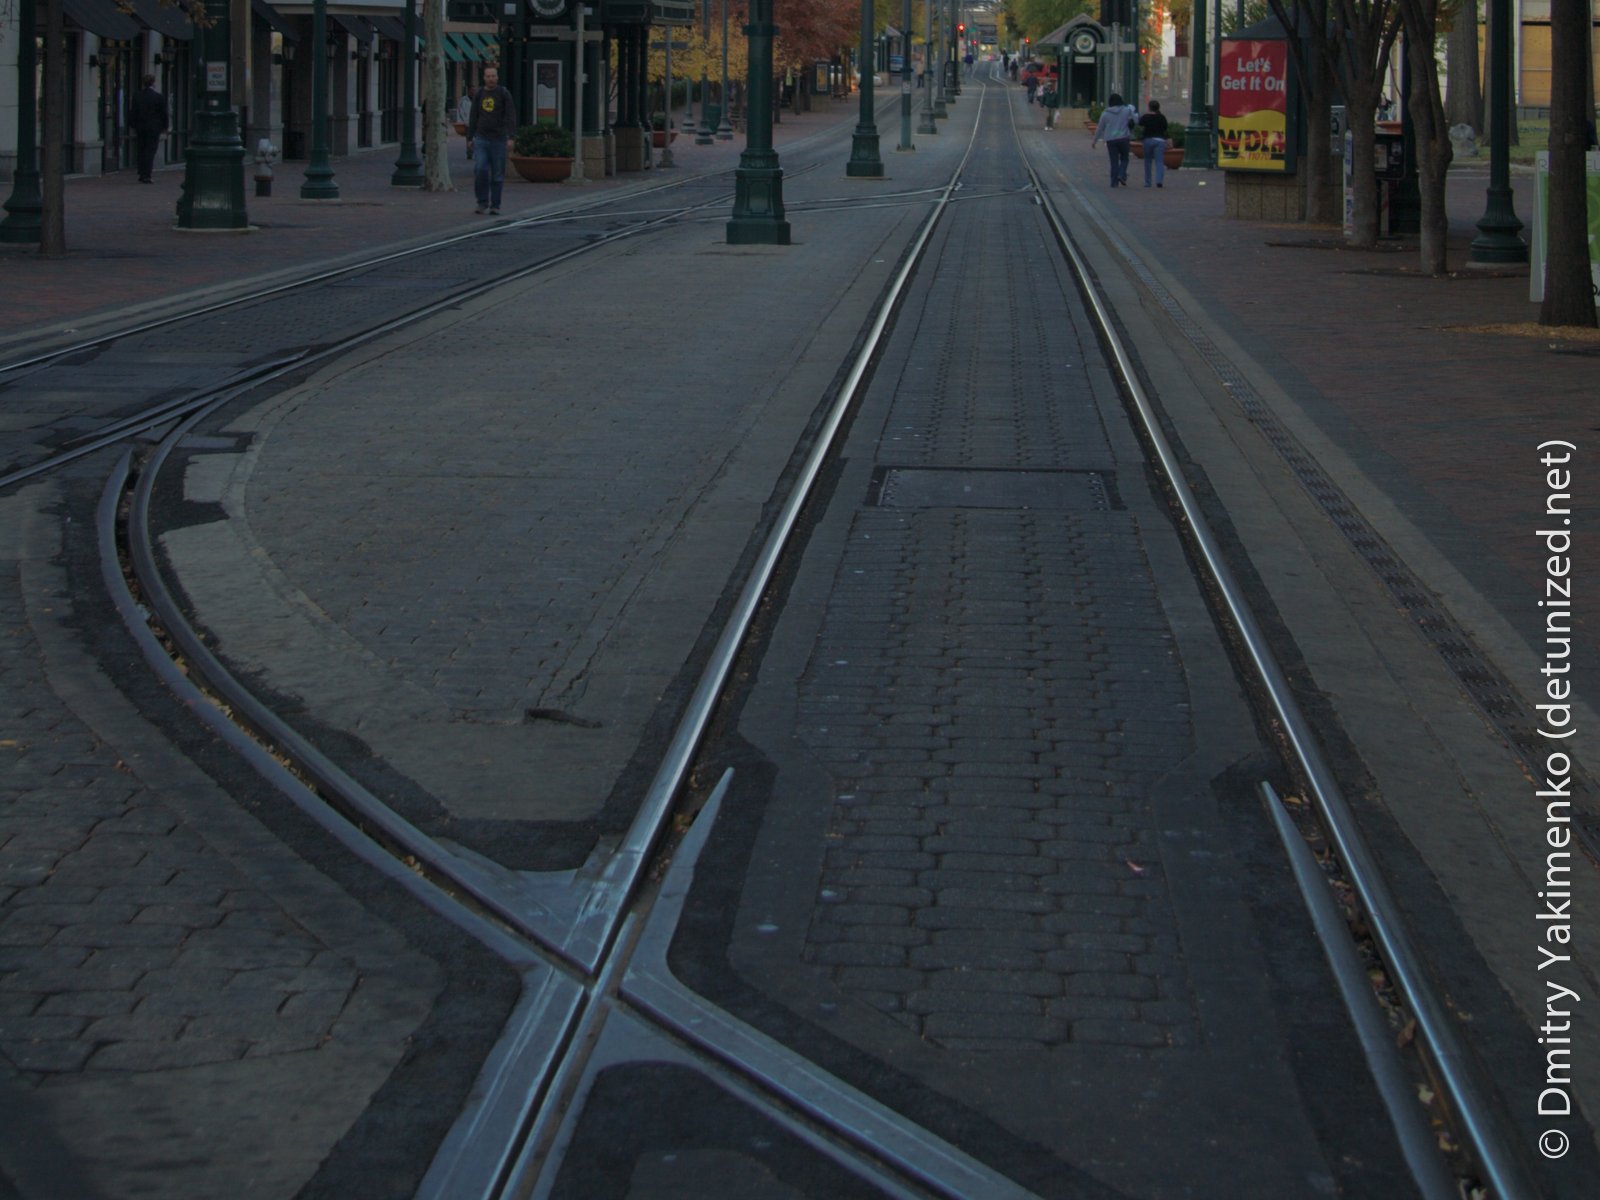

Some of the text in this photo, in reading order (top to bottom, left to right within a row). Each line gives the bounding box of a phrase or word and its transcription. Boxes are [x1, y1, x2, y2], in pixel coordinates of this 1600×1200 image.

[1237, 58, 1272, 73] Let's
[1221, 75, 1285, 91] Get It On
